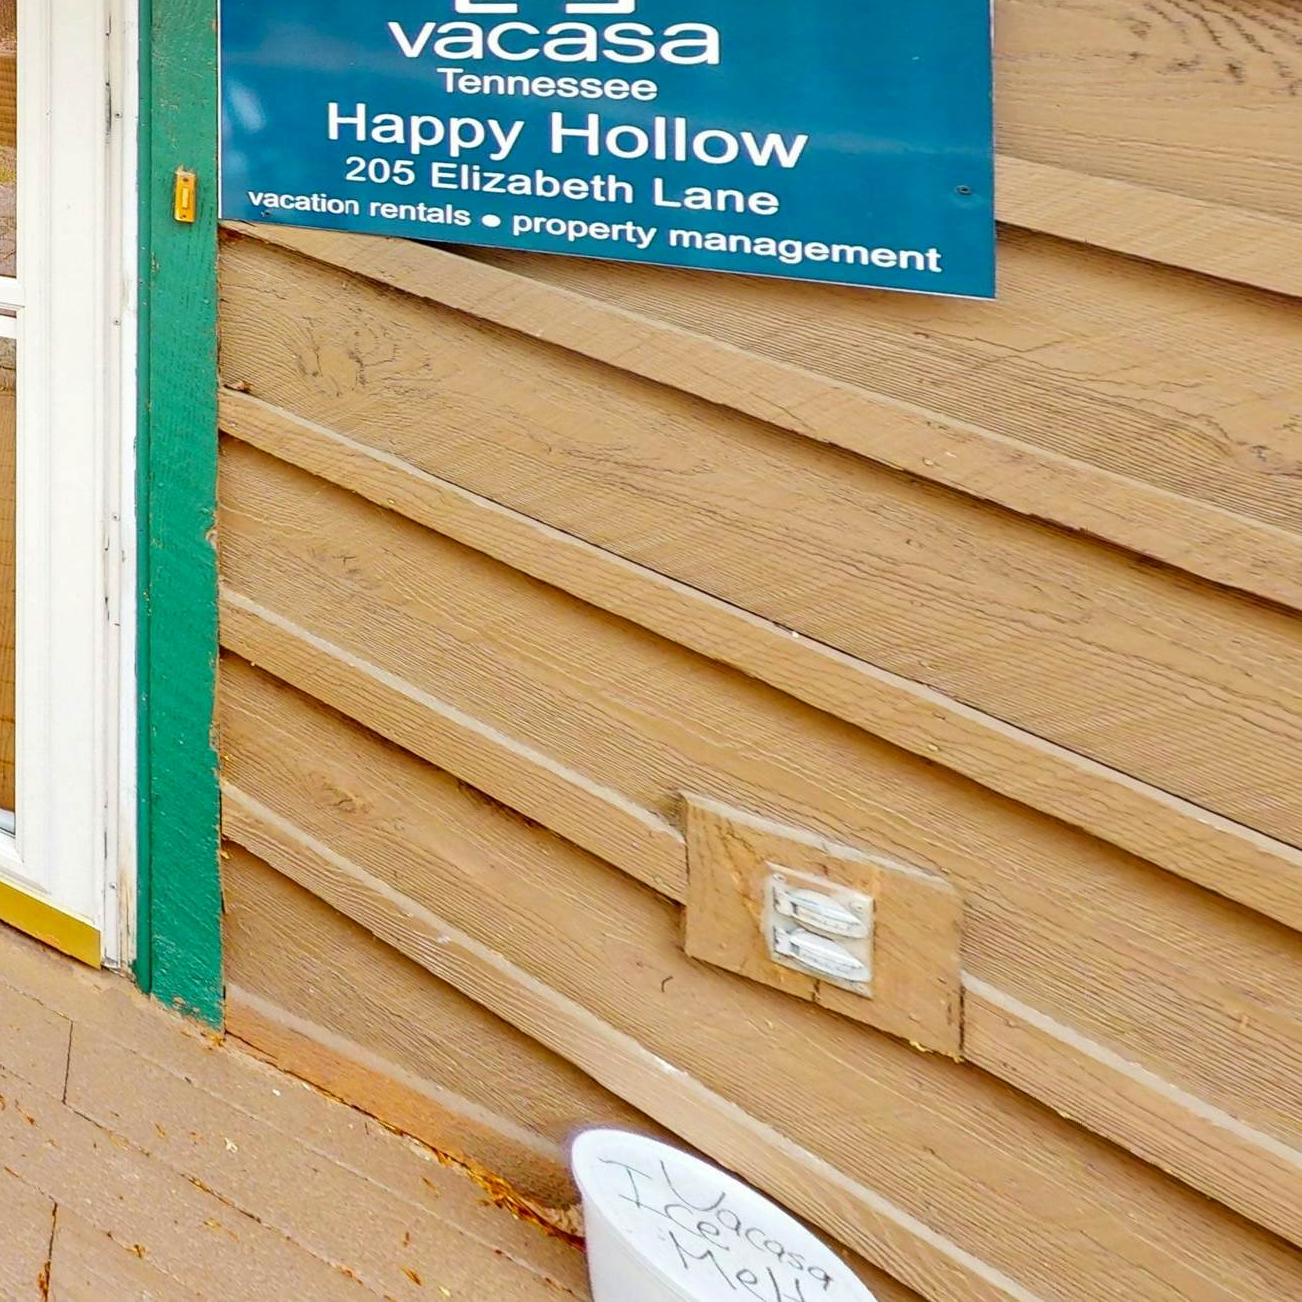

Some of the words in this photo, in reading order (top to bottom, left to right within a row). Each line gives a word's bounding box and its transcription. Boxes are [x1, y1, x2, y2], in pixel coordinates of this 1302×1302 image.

[387, 20, 720, 65] vacasa
[436, 67, 658, 101] Tennessee
[327, 102, 525, 161] Happy
[551, 111, 809, 168] Hollow
[345, 156, 415, 186] 205
[431, 162, 633, 204] Elizabeth
[654, 177, 780, 215] Lane
[248, 188, 360, 215] vacation
[369, 201, 471, 228] rentals
[513, 215, 657, 249] property
[669, 229, 943, 273] management
[659, 1159, 835, 1291] Vacasa
